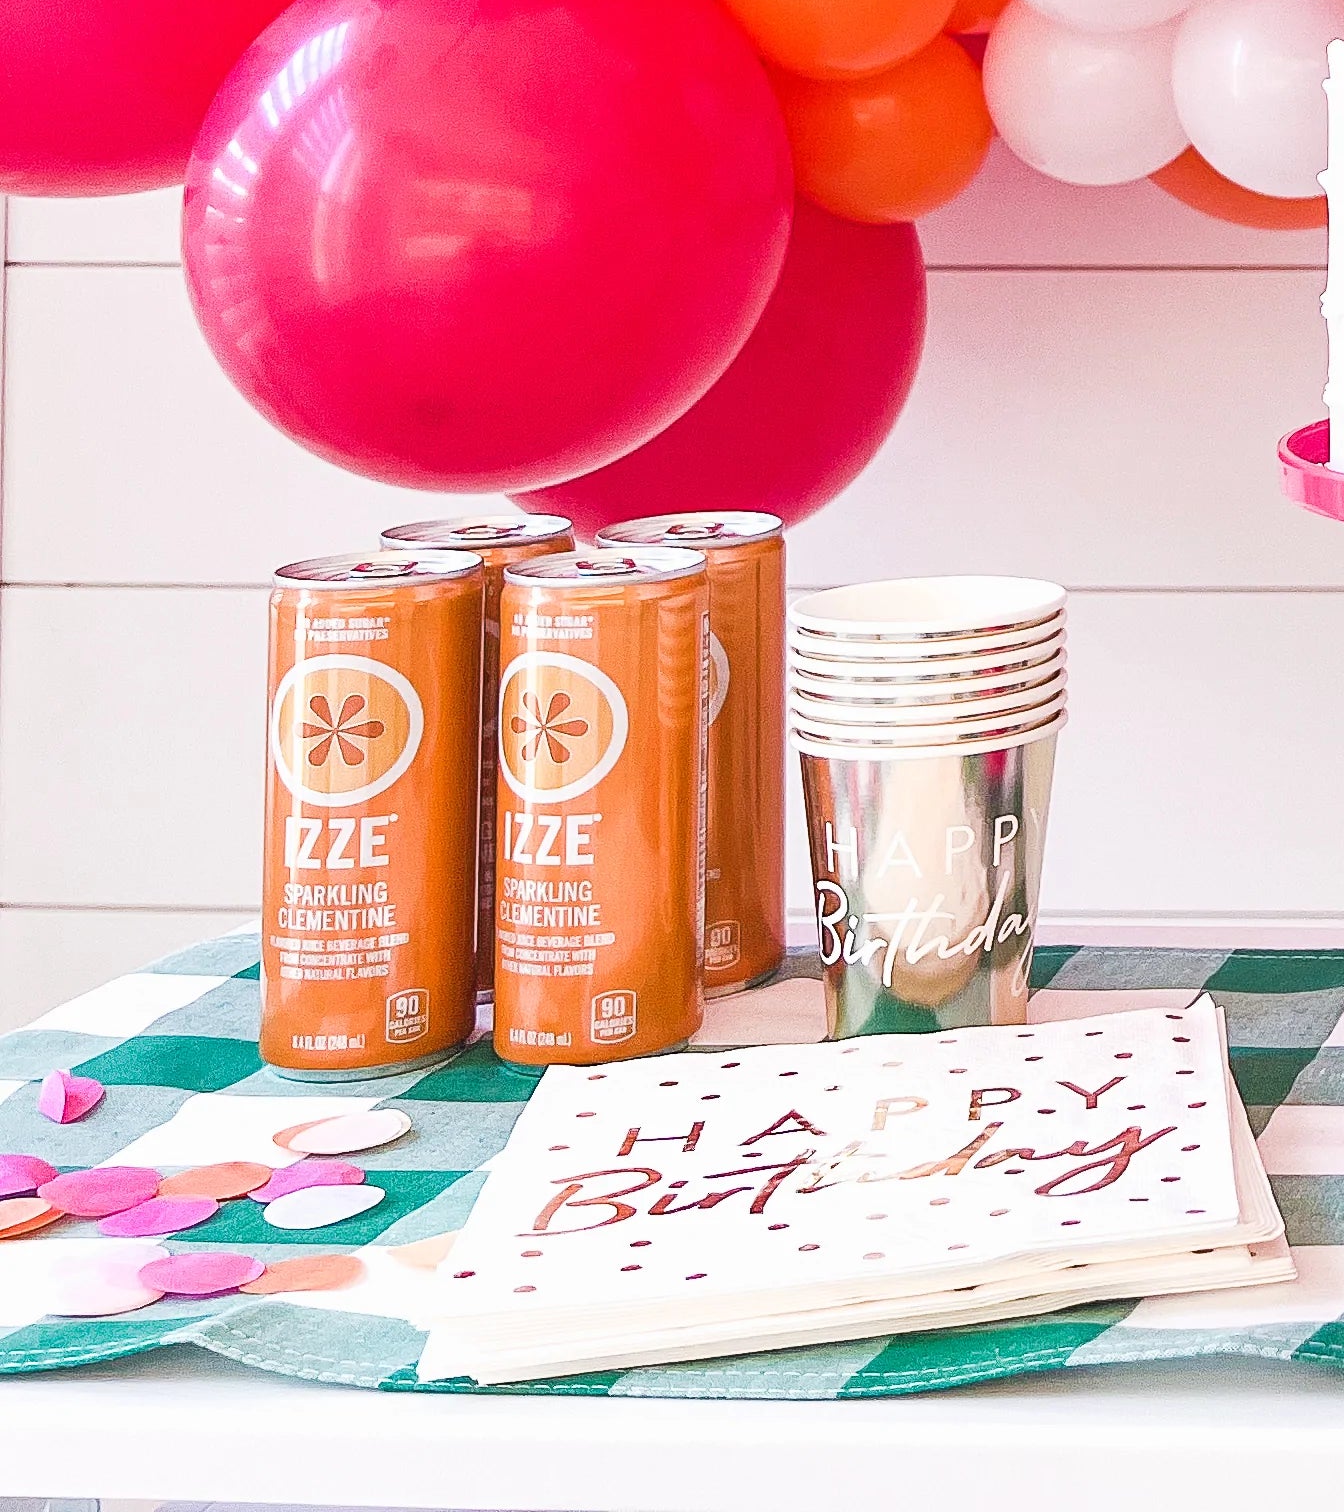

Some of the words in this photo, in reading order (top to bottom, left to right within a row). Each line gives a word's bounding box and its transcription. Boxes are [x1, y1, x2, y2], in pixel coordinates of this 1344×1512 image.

[284, 815, 390, 870] IZZE
[504, 811, 595, 867] IZZE
[825, 807, 1039, 879] HAPP
[283, 881, 388, 907] SPARKLING
[503, 877, 593, 904] SPARKLING
[278, 904, 397, 931] CLEMENTINE
[500, 900, 601, 928] CLEMENTINE
[396, 995, 419, 1018] 90
[601, 996, 626, 1019] 90
[616, 1076, 1128, 1157] HAPPY
